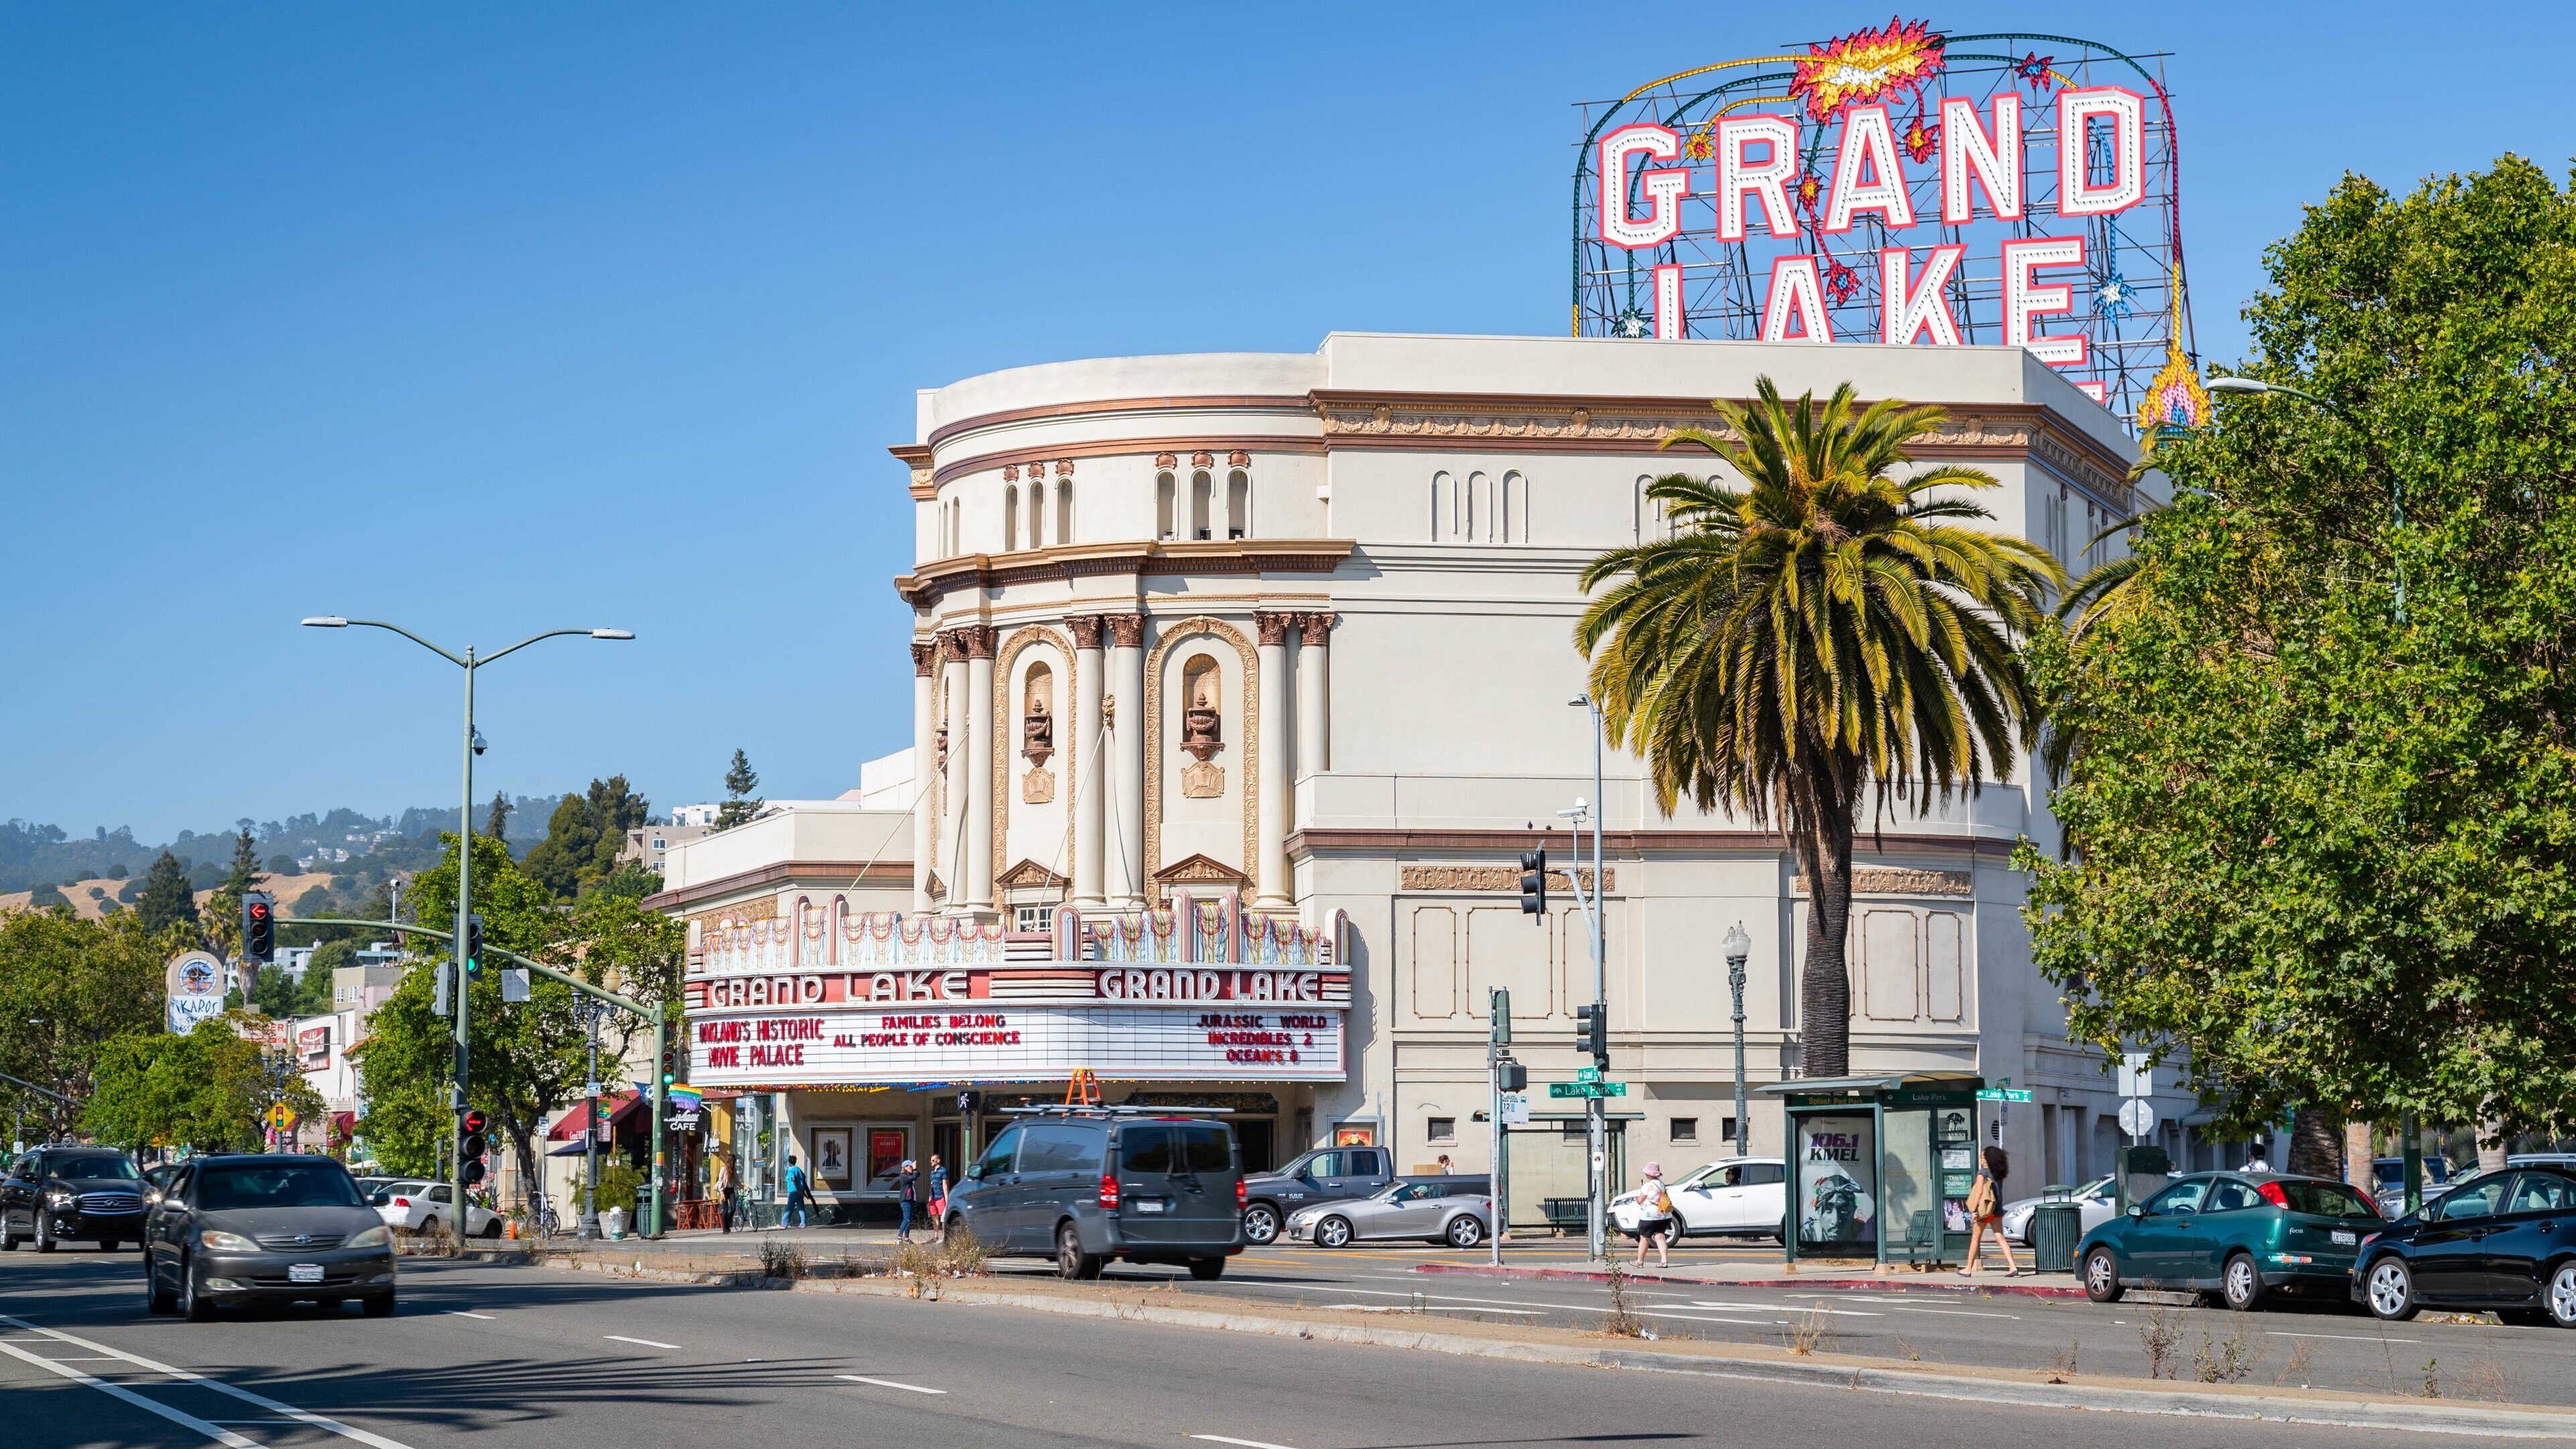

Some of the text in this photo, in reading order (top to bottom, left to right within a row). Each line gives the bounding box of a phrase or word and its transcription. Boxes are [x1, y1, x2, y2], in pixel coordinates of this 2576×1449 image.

[1599, 86, 2145, 250] GRAND
[711, 970, 968, 1007] GRAND LAKE
[1099, 969, 1318, 1002] GRAND LAKE
[176, 999, 218, 1015] IKAROS
[881, 1014, 1006, 1030] FAMILIES BELONG
[1197, 1014, 1327, 1028] JURASSIC WORLD
[699, 1018, 825, 1044] OAKLAND'S HISTORIC
[833, 1030, 1020, 1047] ALL PEOPLE OF CONSCIENCE
[1208, 1032, 1312, 1046] INCREDIBLES 2
[749, 1044, 804, 1067] PALACE
[1226, 1049, 1298, 1063] OCEAN'S 8
[1565, 1086, 1586, 1095] Lake
[1590, 1085, 1610, 1095] Park
[1986, 1090, 2001, 1098] Lake
[2005, 1091, 2019, 1099] Park
[670, 1122, 696, 1131] CAFE
[1811, 1132, 1860, 1148] 106.1
[1810, 1148, 1860, 1161] KMEL
